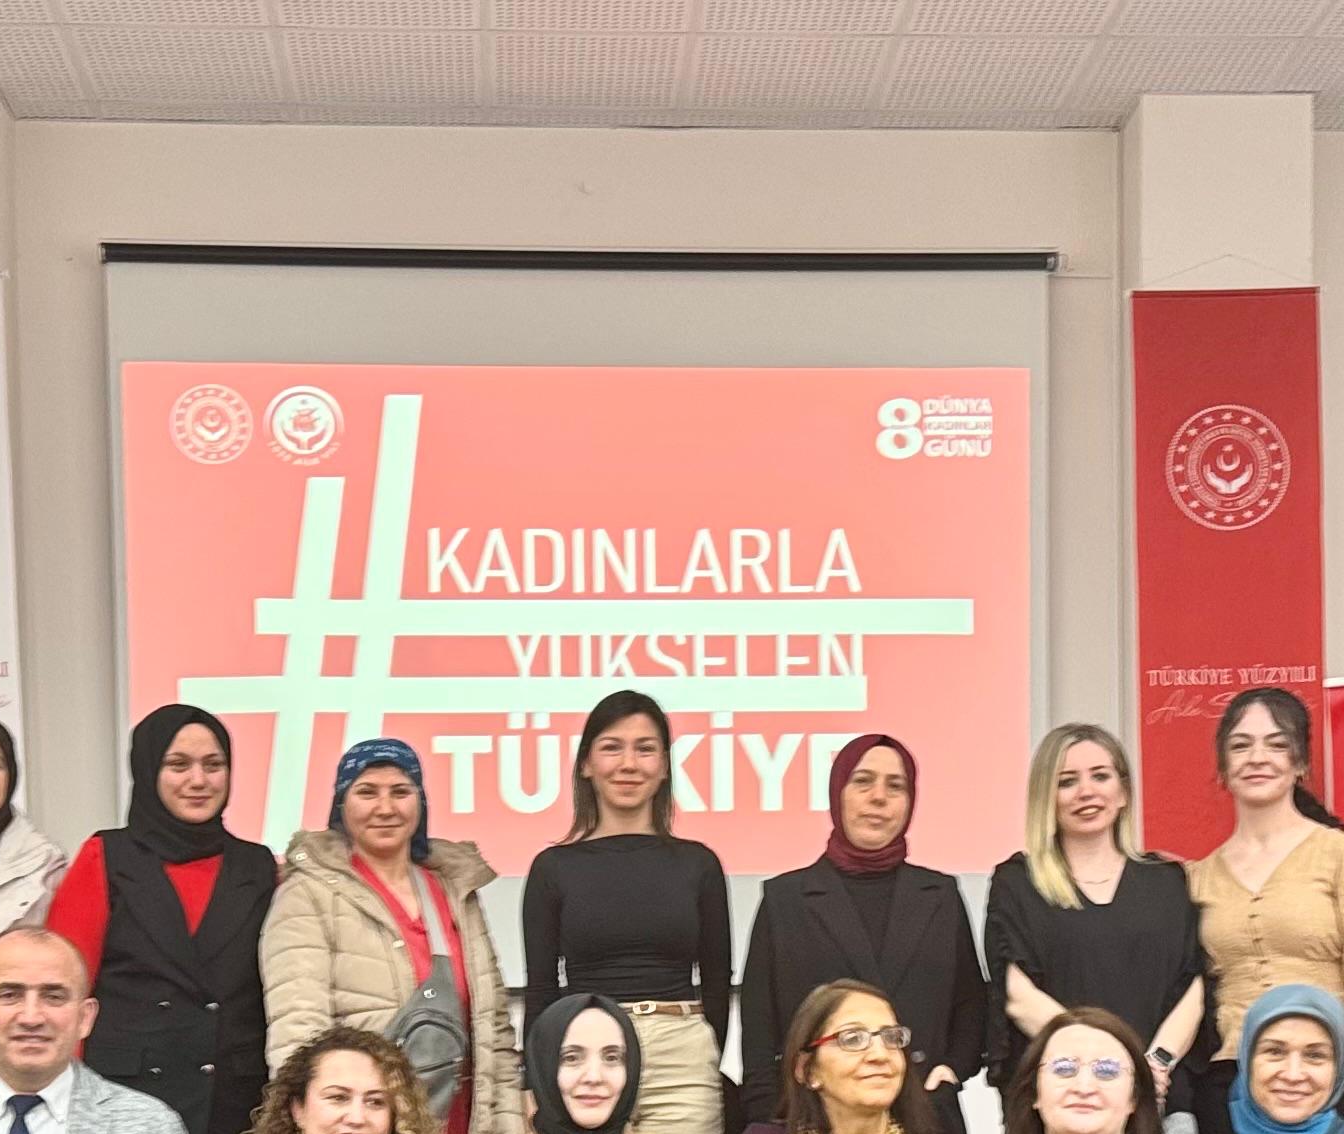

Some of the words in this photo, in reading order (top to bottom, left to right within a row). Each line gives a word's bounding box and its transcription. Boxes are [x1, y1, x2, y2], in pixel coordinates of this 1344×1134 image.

[922, 395, 994, 415] DÜNYA
[876, 397, 923, 460] 8
[923, 435, 993, 459] GÜNÜ
[427, 527, 863, 594] KADINLARLA
[1146, 664, 1233, 687] TÜRKİYE
[1237, 663, 1317, 685] YÜZYILI
[431, 712, 858, 814] TÜKİYE
